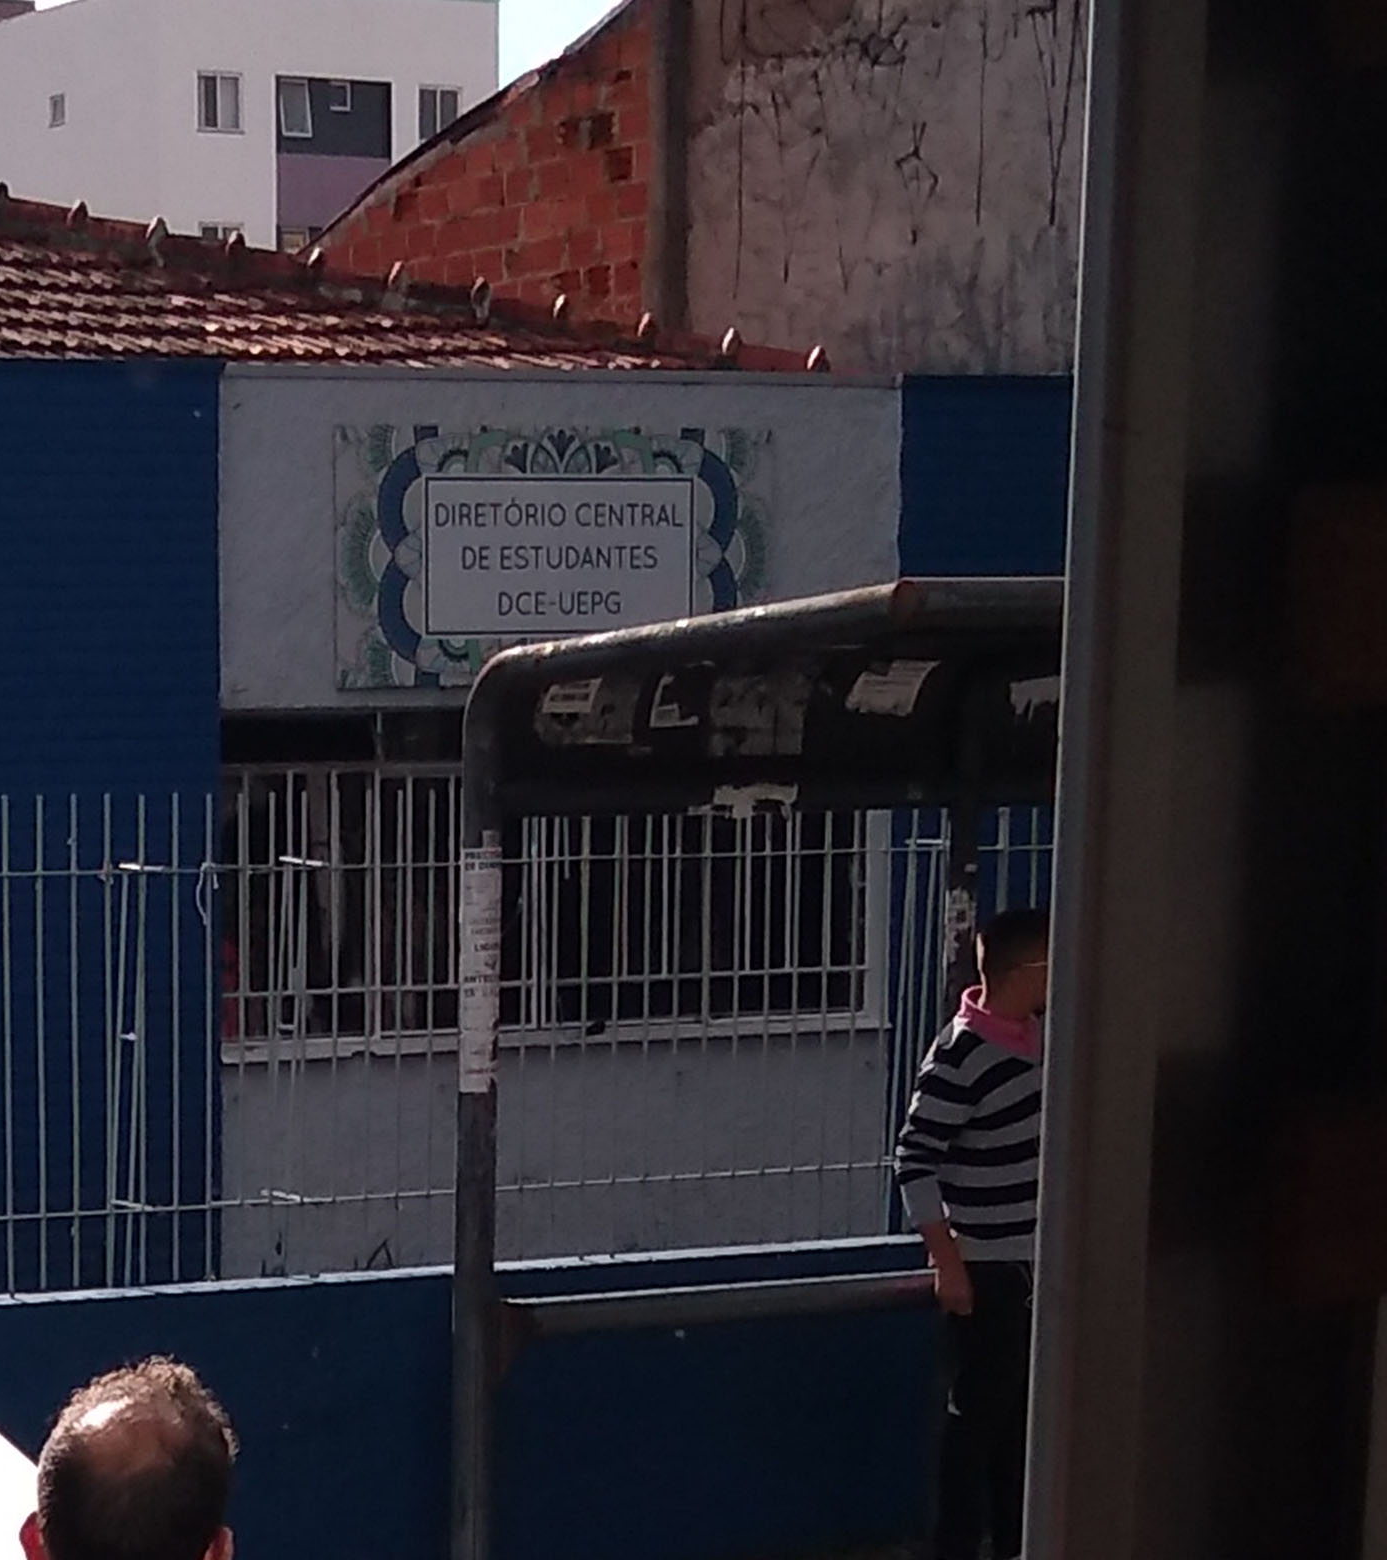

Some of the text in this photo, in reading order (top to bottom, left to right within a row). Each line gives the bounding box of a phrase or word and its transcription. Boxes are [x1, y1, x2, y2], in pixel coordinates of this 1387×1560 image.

[434, 498, 684, 528] DIRETÓRIO CENTRAL
[461, 546, 659, 570] DE ESTUDANTES
[498, 591, 622, 616] DCE-UEPG
